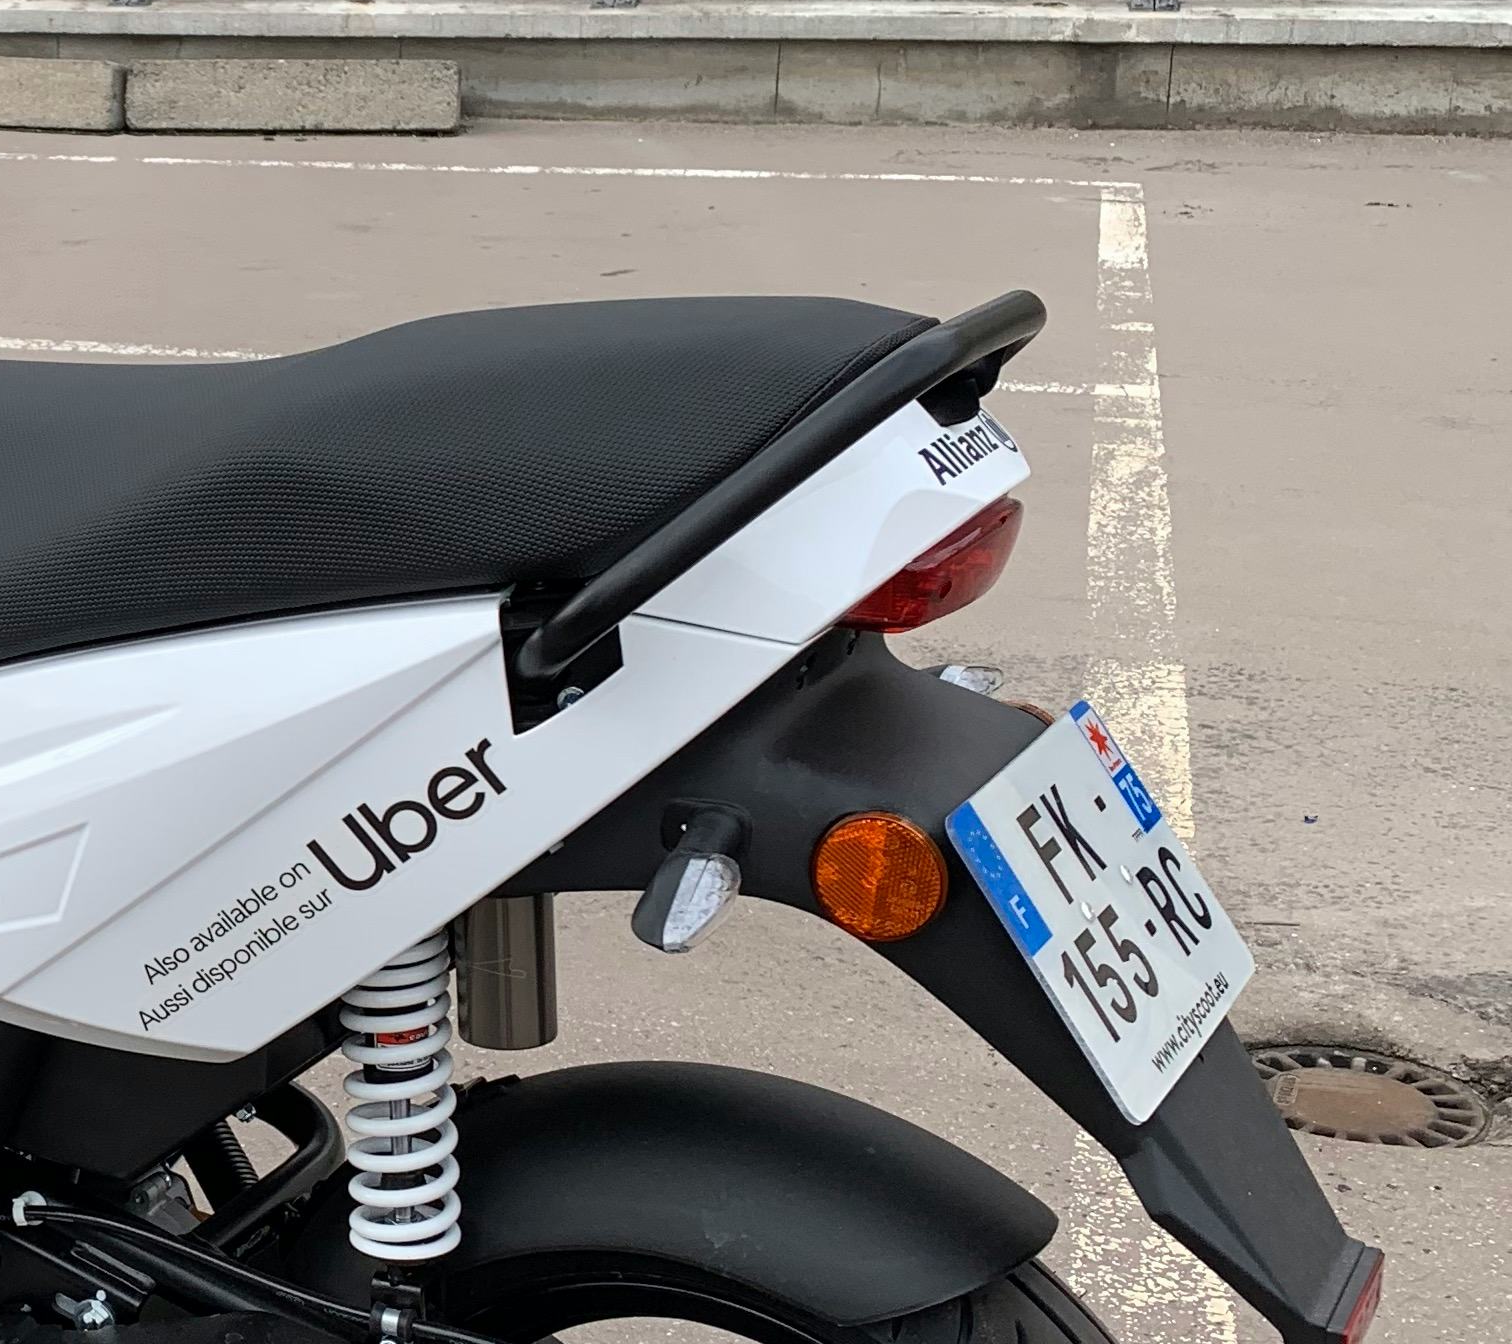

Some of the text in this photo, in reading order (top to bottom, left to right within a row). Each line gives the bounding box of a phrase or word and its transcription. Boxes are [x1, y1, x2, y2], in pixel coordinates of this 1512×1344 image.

[918, 425, 999, 486] Allianz
[306, 738, 507, 891] Uber
[1119, 773, 1152, 821] 75
[139, 888, 333, 1031] Aussi disponible sur
[143, 862, 311, 984] Also available on
[1009, 895, 1030, 930] F
[1152, 972, 1230, 1074] www.cityscoot.eu
